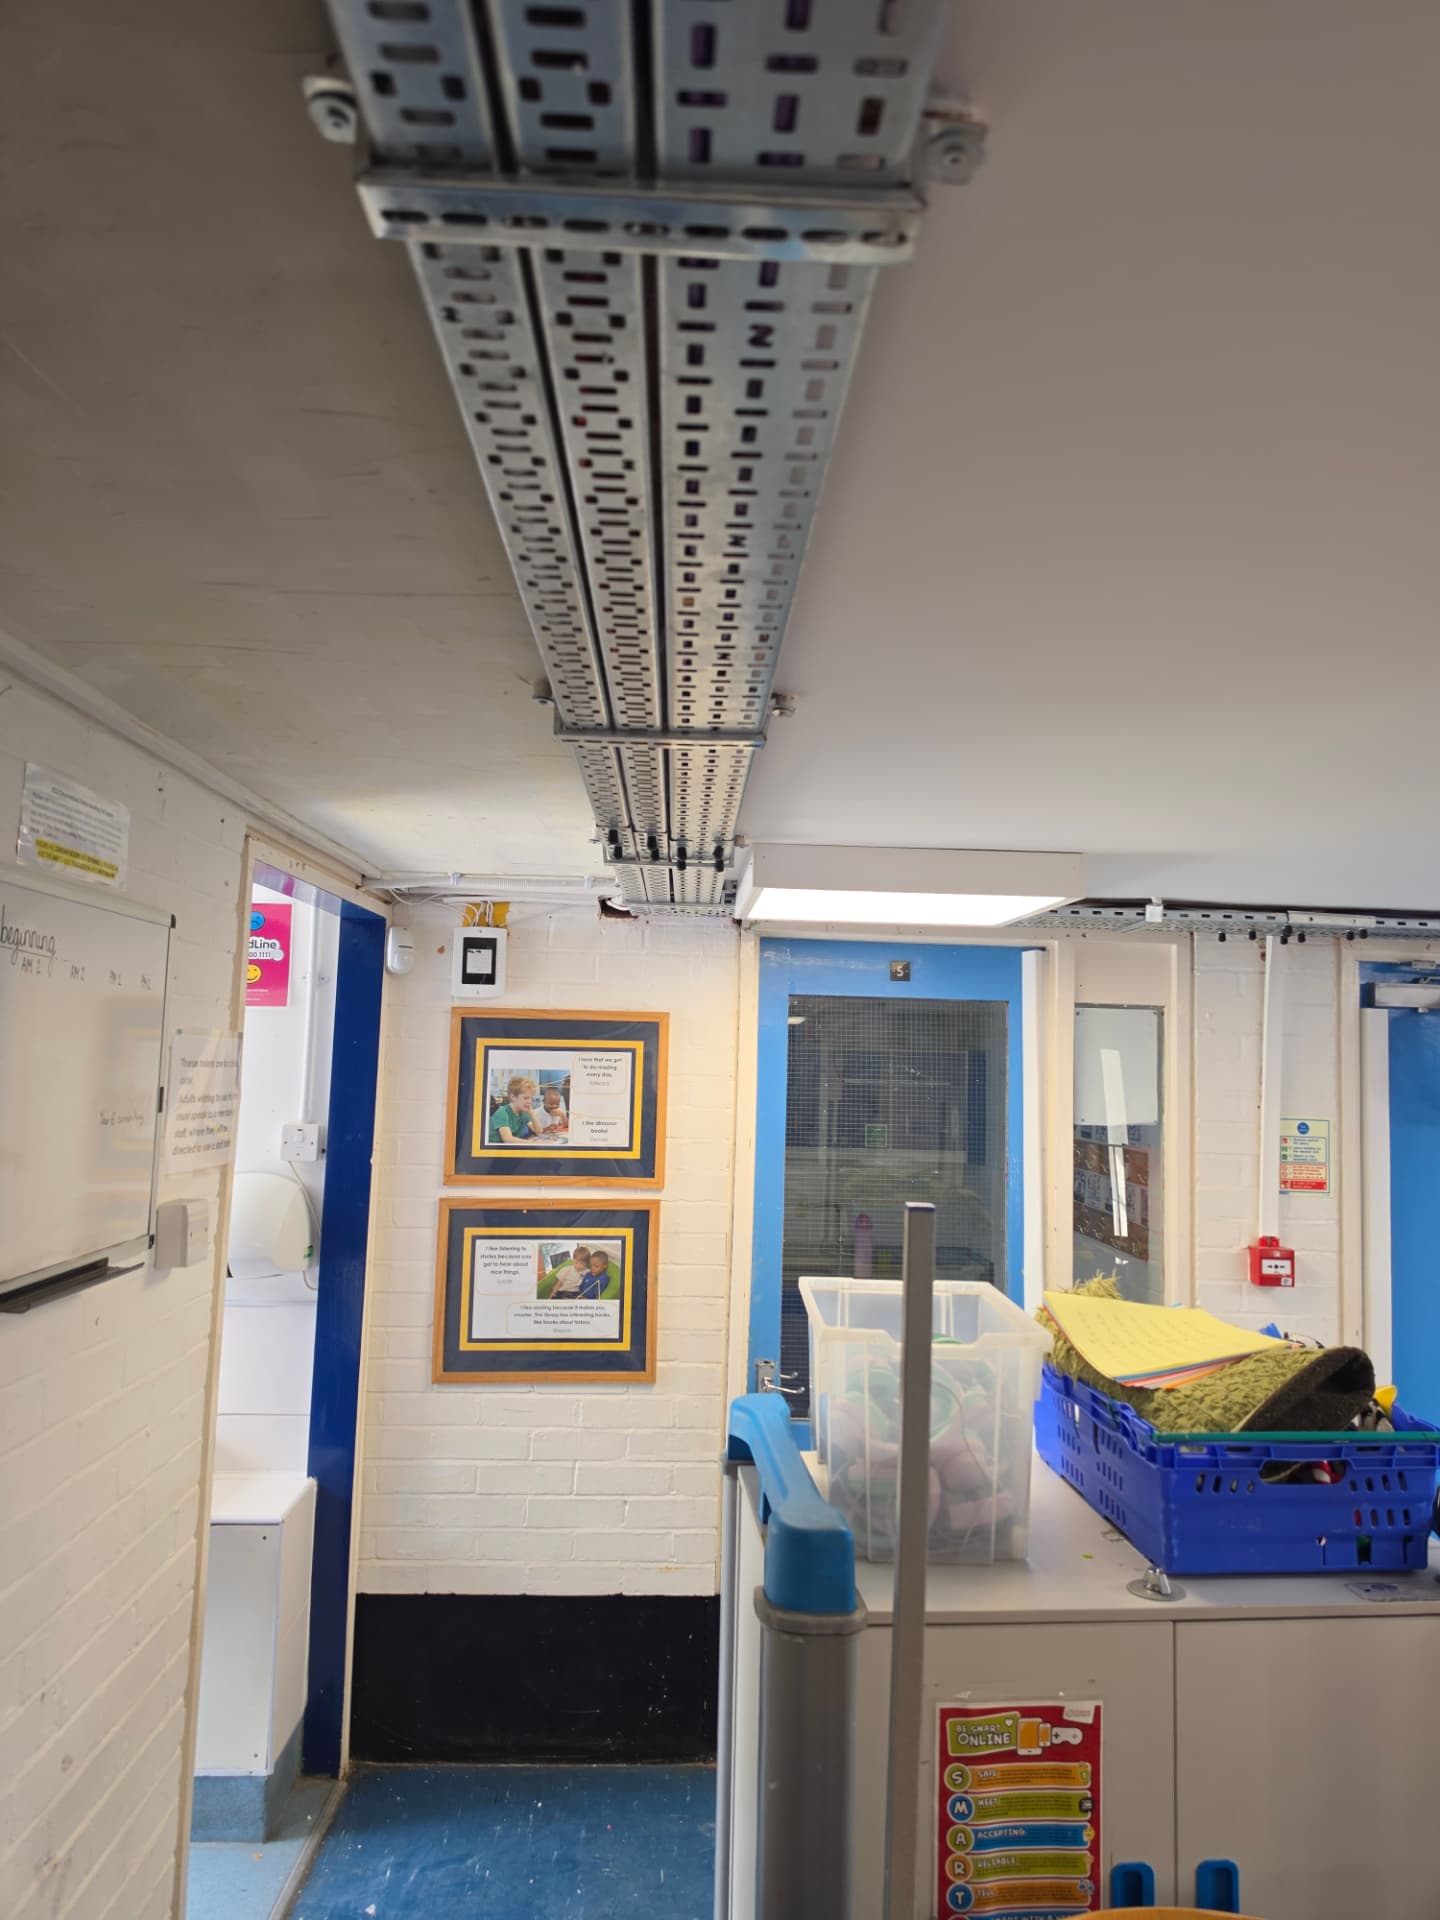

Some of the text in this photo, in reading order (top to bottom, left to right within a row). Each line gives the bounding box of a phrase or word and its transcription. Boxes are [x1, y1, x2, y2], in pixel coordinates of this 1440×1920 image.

[248, 939, 277, 949] dLine
[956, 1724, 1001, 1734] BE SMART
[957, 1732, 1011, 1747] ONLINE
[952, 1770, 963, 1785] S
[977, 1769, 998, 1779] SAFE
[953, 1801, 969, 1815] M
[977, 1798, 998, 1807] MEET
[955, 1831, 966, 1845] A
[977, 1828, 1026, 1839] ACCEPTING
[954, 1861, 966, 1875] R
[977, 1856, 1016, 1868] RELIABLE
[955, 1891, 966, 1905] T
